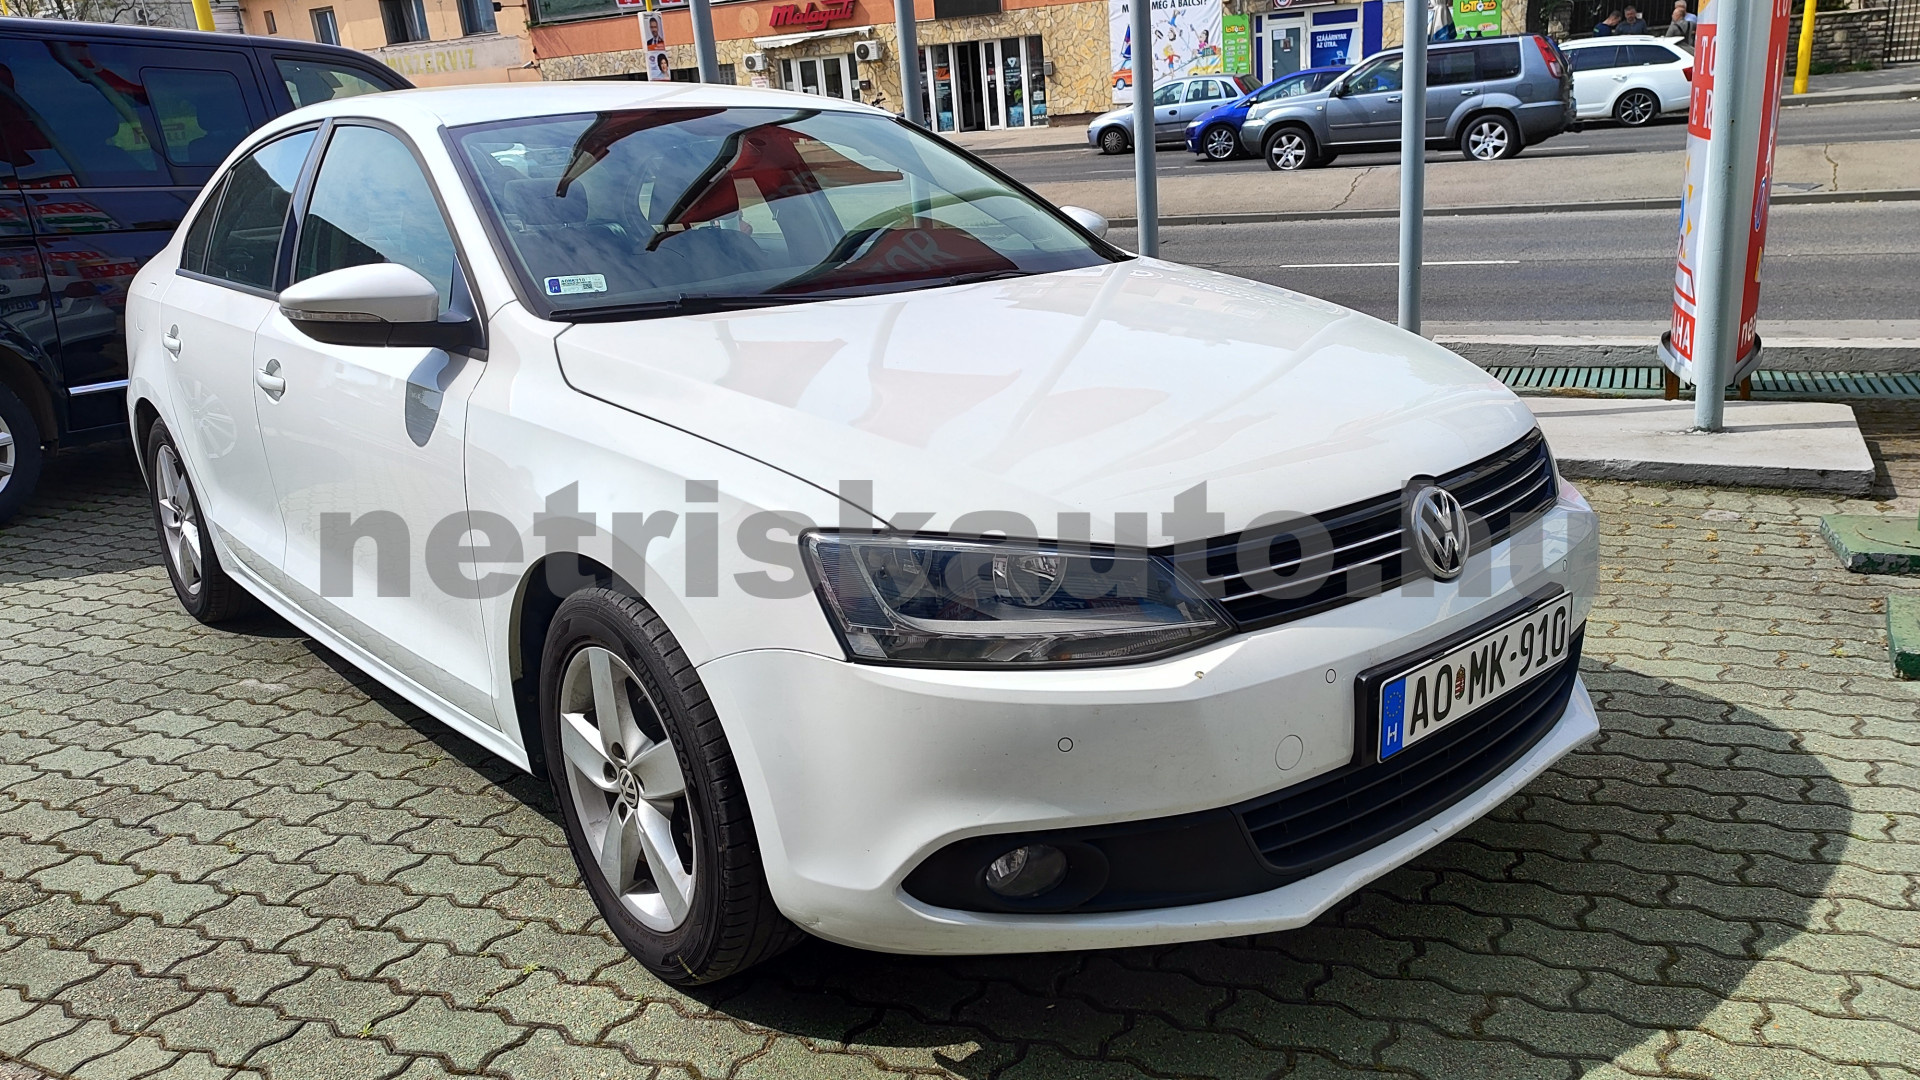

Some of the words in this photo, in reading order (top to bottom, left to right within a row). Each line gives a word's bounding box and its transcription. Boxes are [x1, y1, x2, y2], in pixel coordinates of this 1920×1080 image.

[769, 0, 856, 31] Malaguti
[1151, 1, 1168, 10] MEG
[1170, 0, 1176, 8] A
[1386, 722, 1399, 746] H
